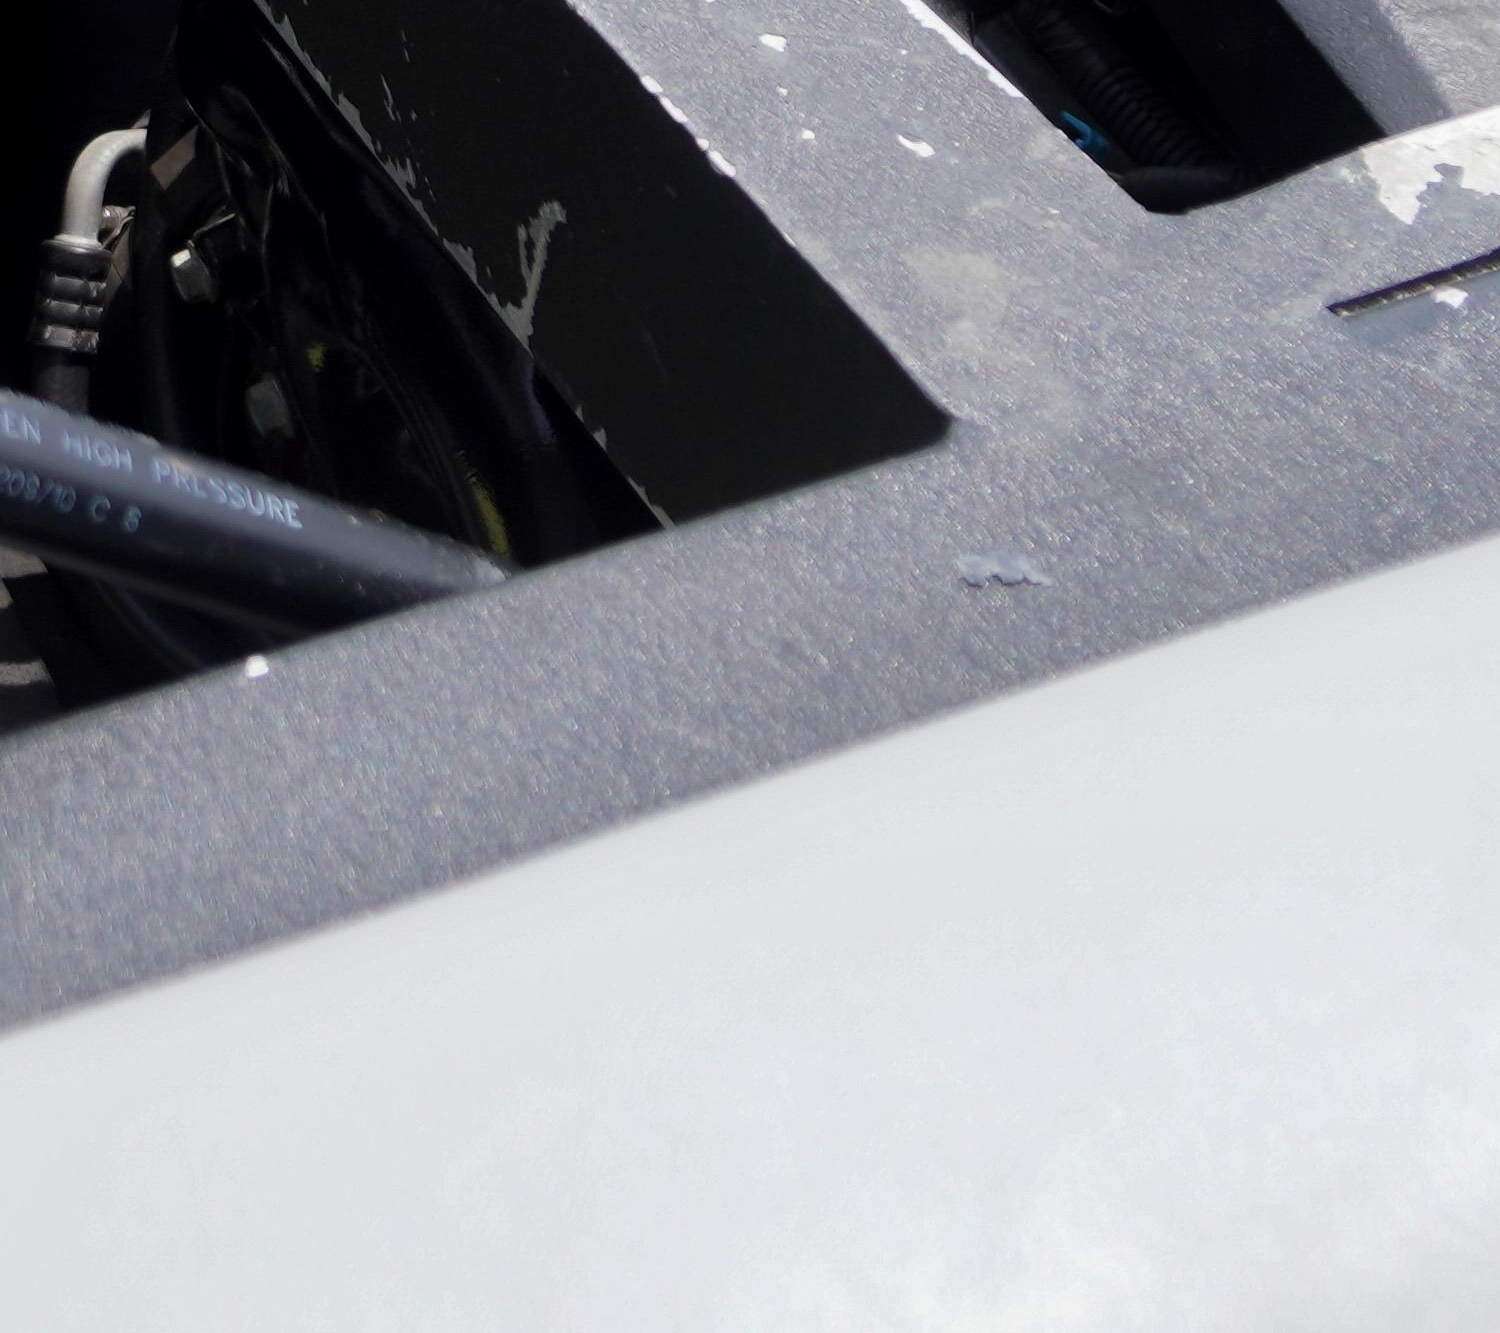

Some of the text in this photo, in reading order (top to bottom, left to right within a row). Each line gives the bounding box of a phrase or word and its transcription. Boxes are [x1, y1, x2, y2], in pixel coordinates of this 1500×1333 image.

[63, 429, 134, 473] HIGH
[152, 459, 303, 529] PRESSURE
[87, 493, 112, 524] C
